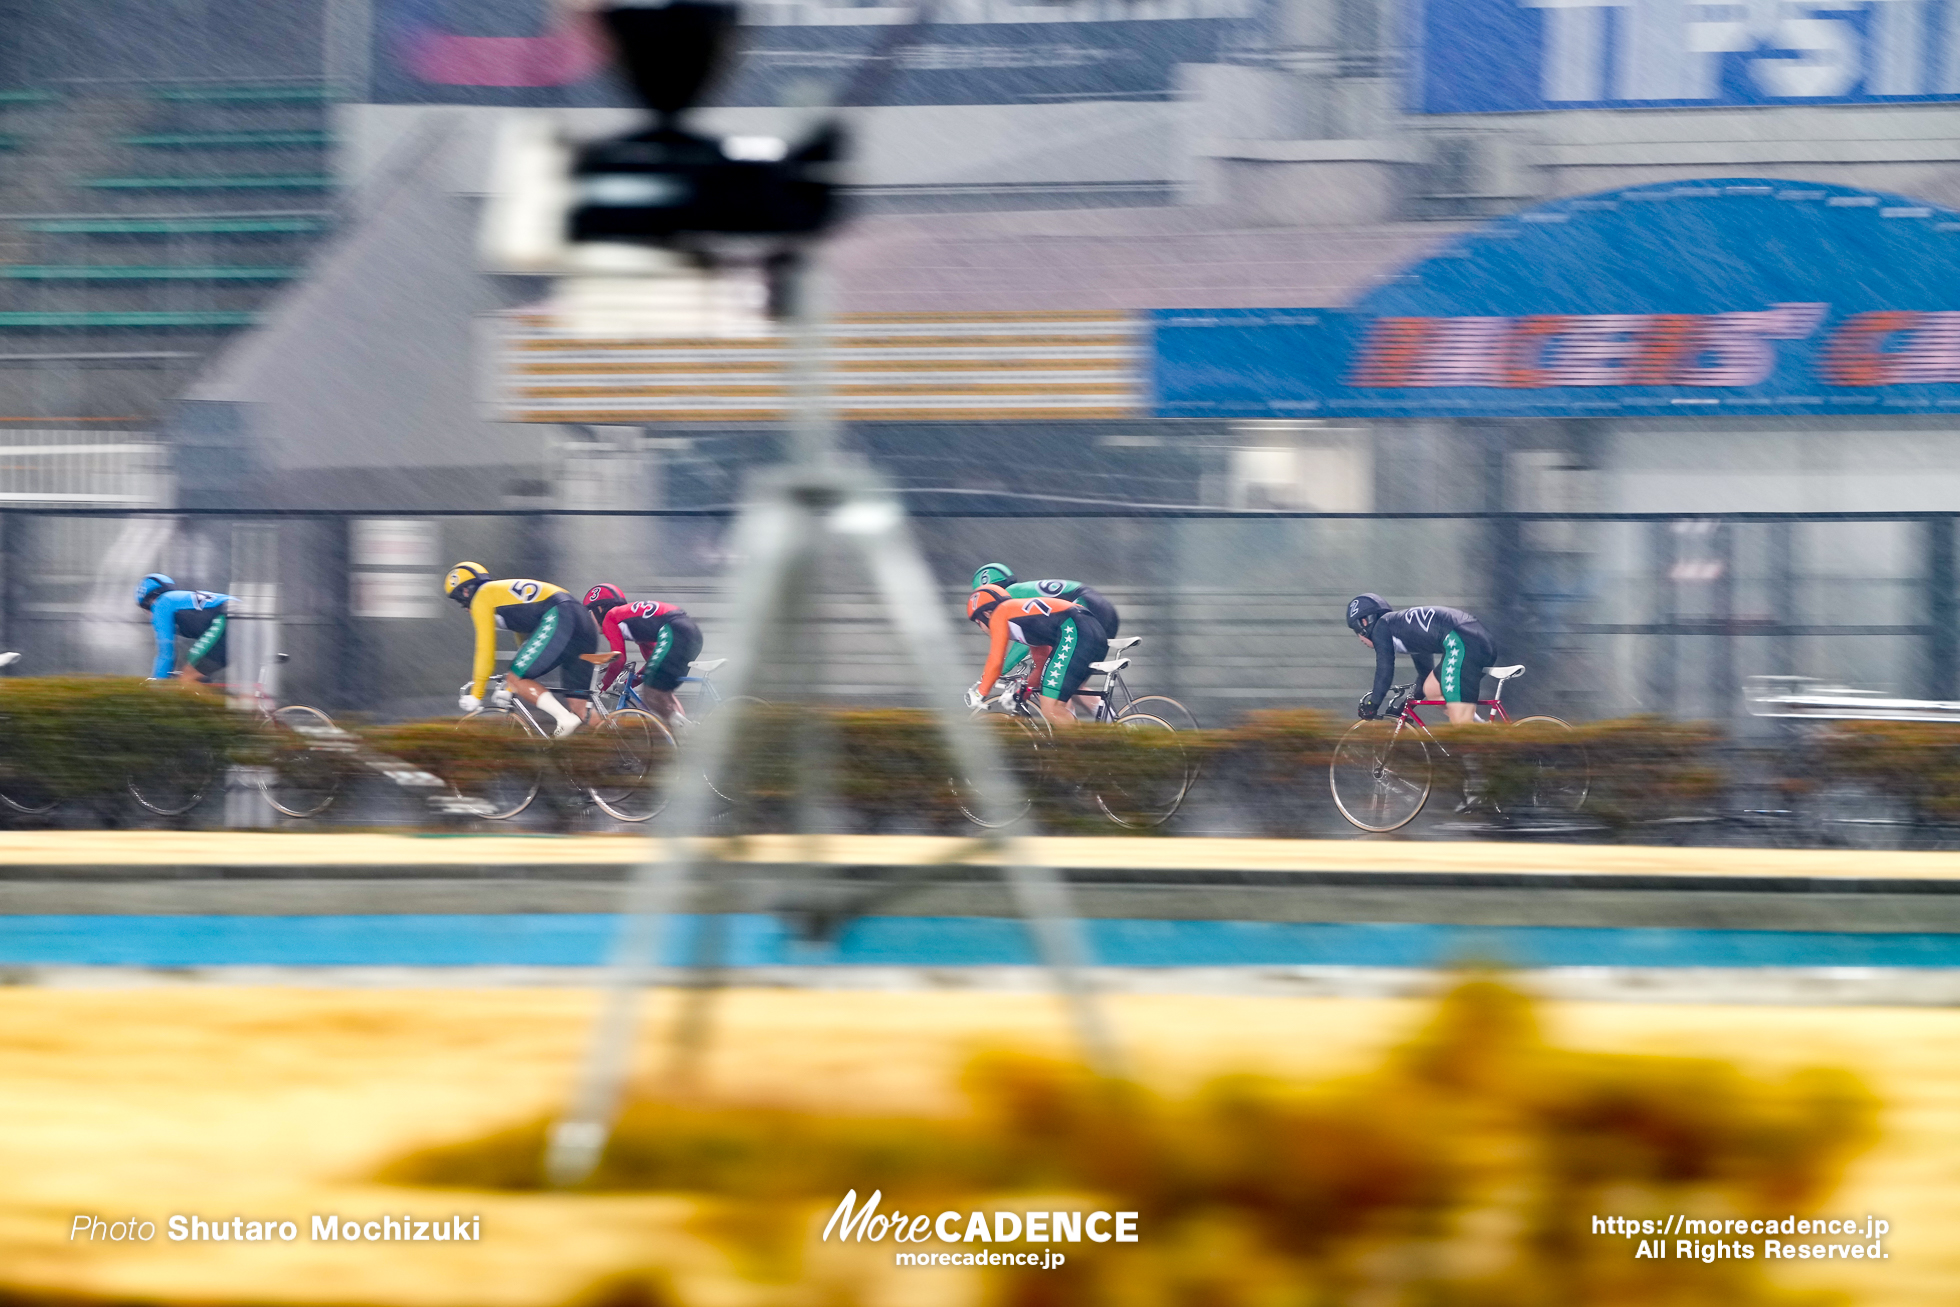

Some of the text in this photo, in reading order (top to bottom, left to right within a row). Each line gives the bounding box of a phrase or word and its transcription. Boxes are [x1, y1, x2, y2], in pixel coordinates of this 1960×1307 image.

[980, 569, 991, 585] 6
[508, 579, 543, 603] 5
[589, 587, 602, 602] 3
[1035, 579, 1068, 597] 6
[630, 599, 660, 619] 3
[969, 592, 981, 611] 7
[1021, 597, 1053, 617] 7
[1349, 599, 1360, 618] 2
[1405, 606, 1436, 633] 2
